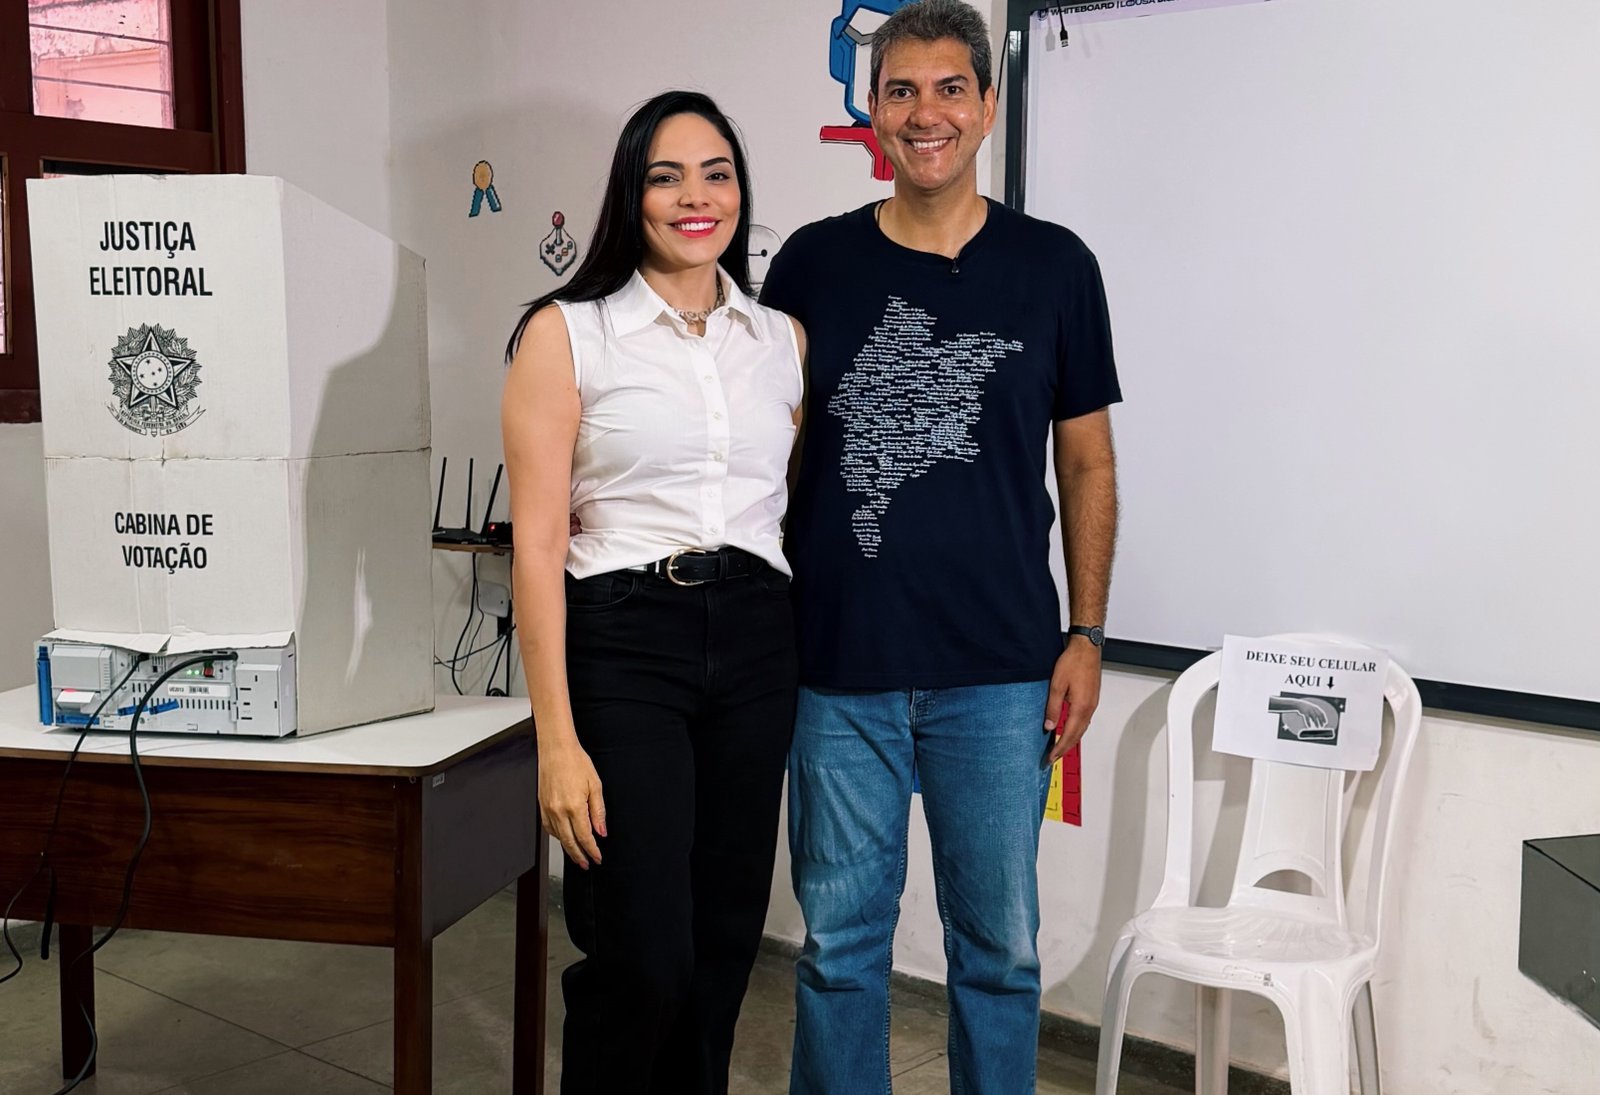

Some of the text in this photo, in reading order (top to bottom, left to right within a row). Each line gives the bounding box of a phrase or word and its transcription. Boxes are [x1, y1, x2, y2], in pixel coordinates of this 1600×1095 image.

[1050, 3, 1115, 16] WHITEBOARD
[99, 221, 196, 259] JUSTIÇA
[90, 266, 213, 297] ELEITORAL
[114, 513, 214, 536] CABINA DE
[122, 543, 208, 574] VOTAÇÃO
[1246, 650, 1377, 673] DEIXE SEU CELULAR
[1284, 673, 1320, 688] AQUI
